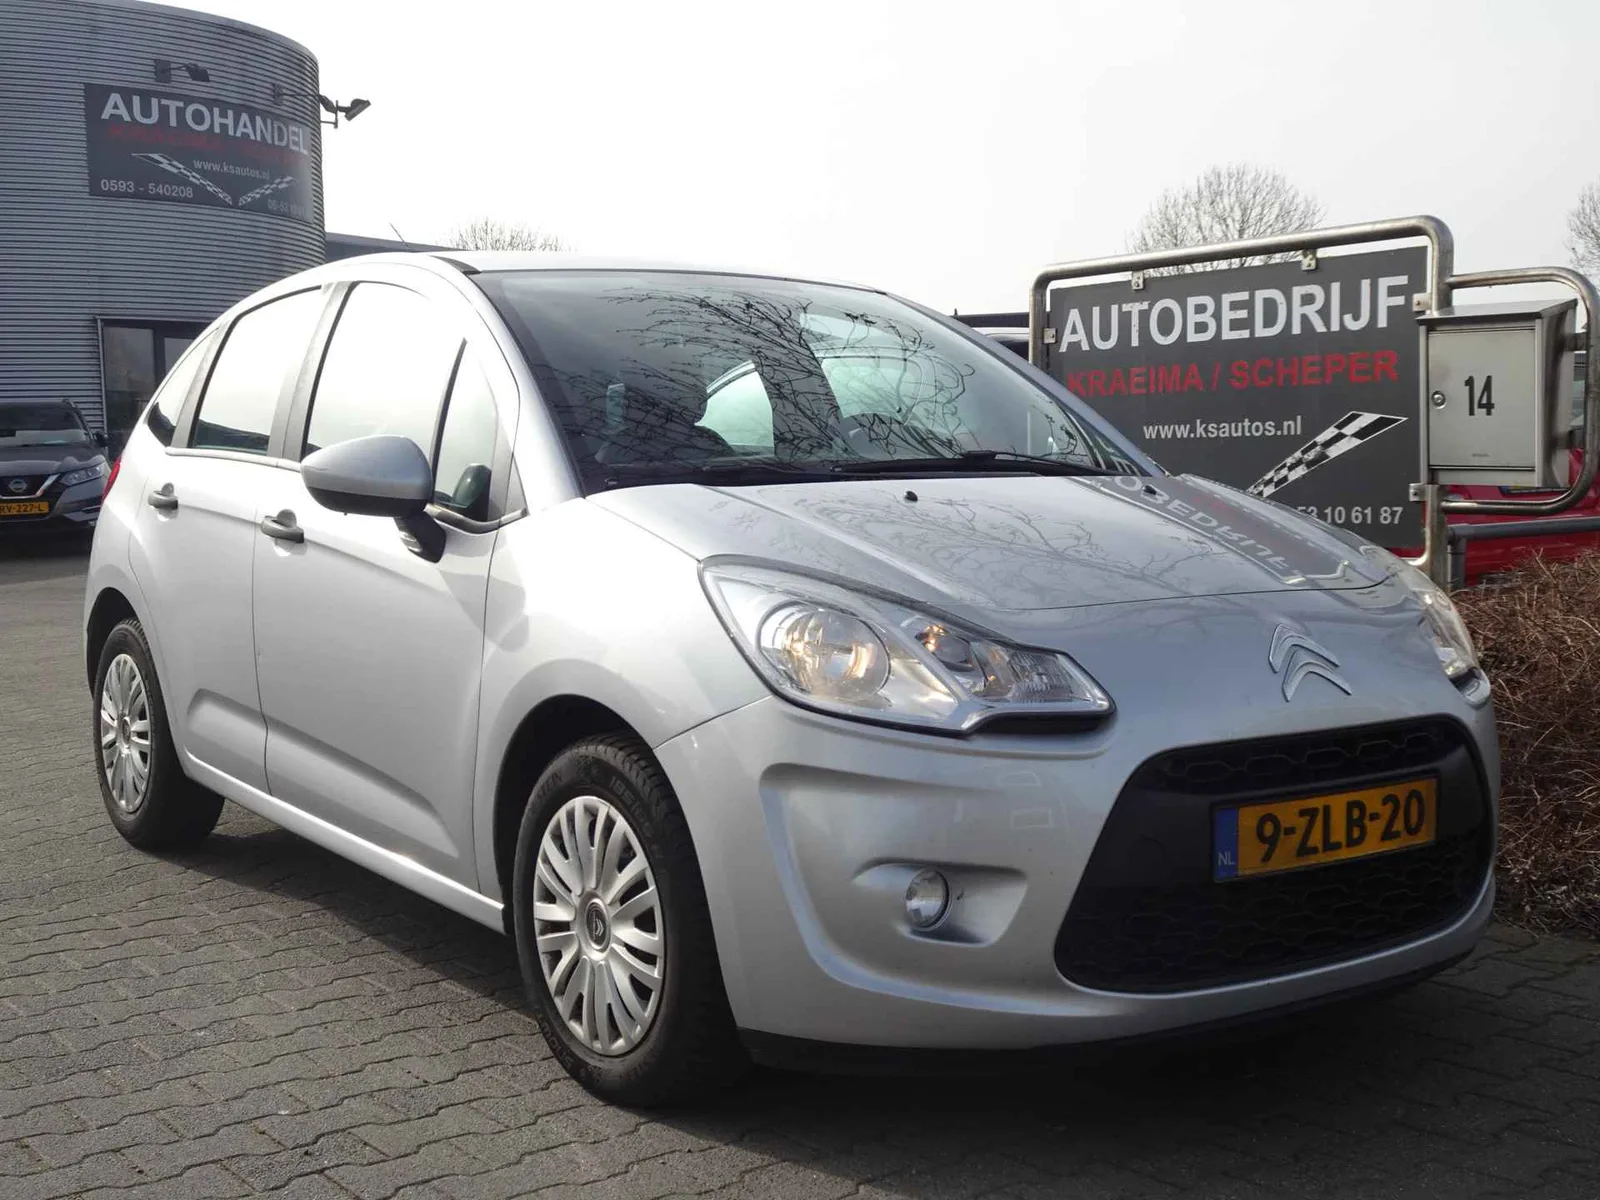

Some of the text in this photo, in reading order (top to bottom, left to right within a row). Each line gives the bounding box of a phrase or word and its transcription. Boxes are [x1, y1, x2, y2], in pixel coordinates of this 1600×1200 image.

[101, 92, 308, 155] AUTOHANDEL
[100, 179, 134, 193] 0593
[148, 183, 194, 199] 540208
[193, 158, 271, 180] www.ksautos.nl
[1058, 274, 1410, 353] AUTOBEDRIJF
[1067, 362, 1206, 398] KRAEIMA
[1229, 350, 1400, 392] SCHEPER
[1464, 375, 1496, 417] 14
[1142, 415, 1302, 441] www.ksautos.nl
[1324, 506, 1346, 524] 10
[1351, 506, 1372, 524] 61
[1379, 506, 1403, 524] 87
[1217, 788, 1425, 866] NL 9-ZLB-20
